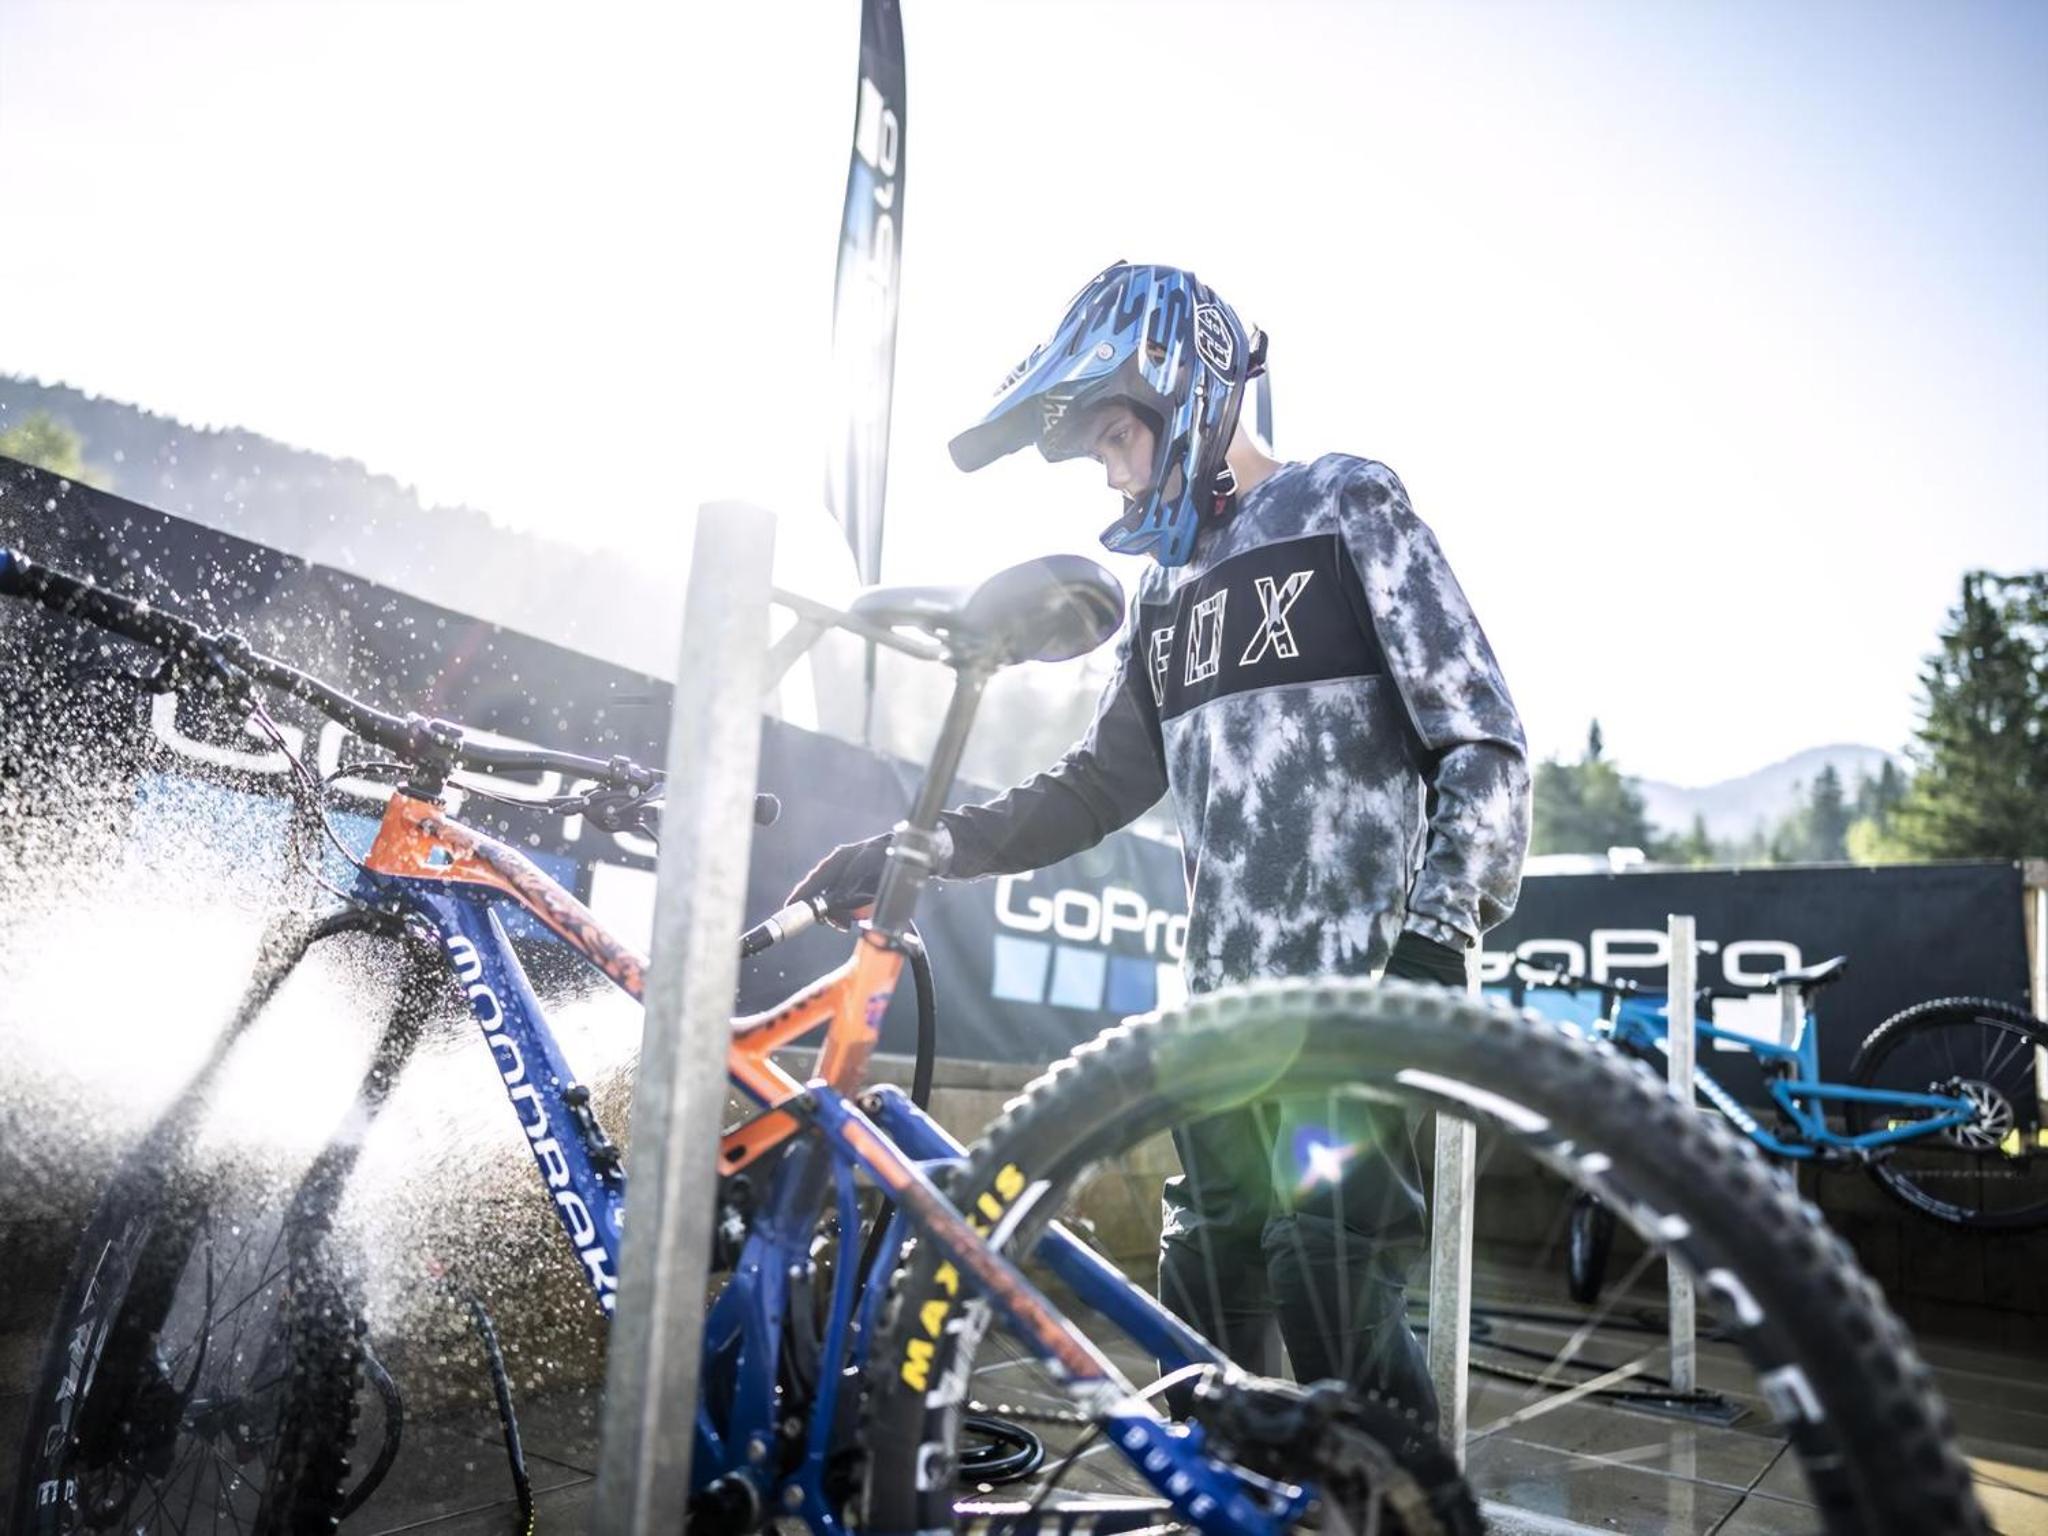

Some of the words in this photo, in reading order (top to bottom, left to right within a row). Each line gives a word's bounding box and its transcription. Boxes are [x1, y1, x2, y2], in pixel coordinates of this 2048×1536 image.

[1149, 570, 1314, 707] FOX
[151, 690, 658, 858] GPr
[1480, 929, 1801, 986] oPo
